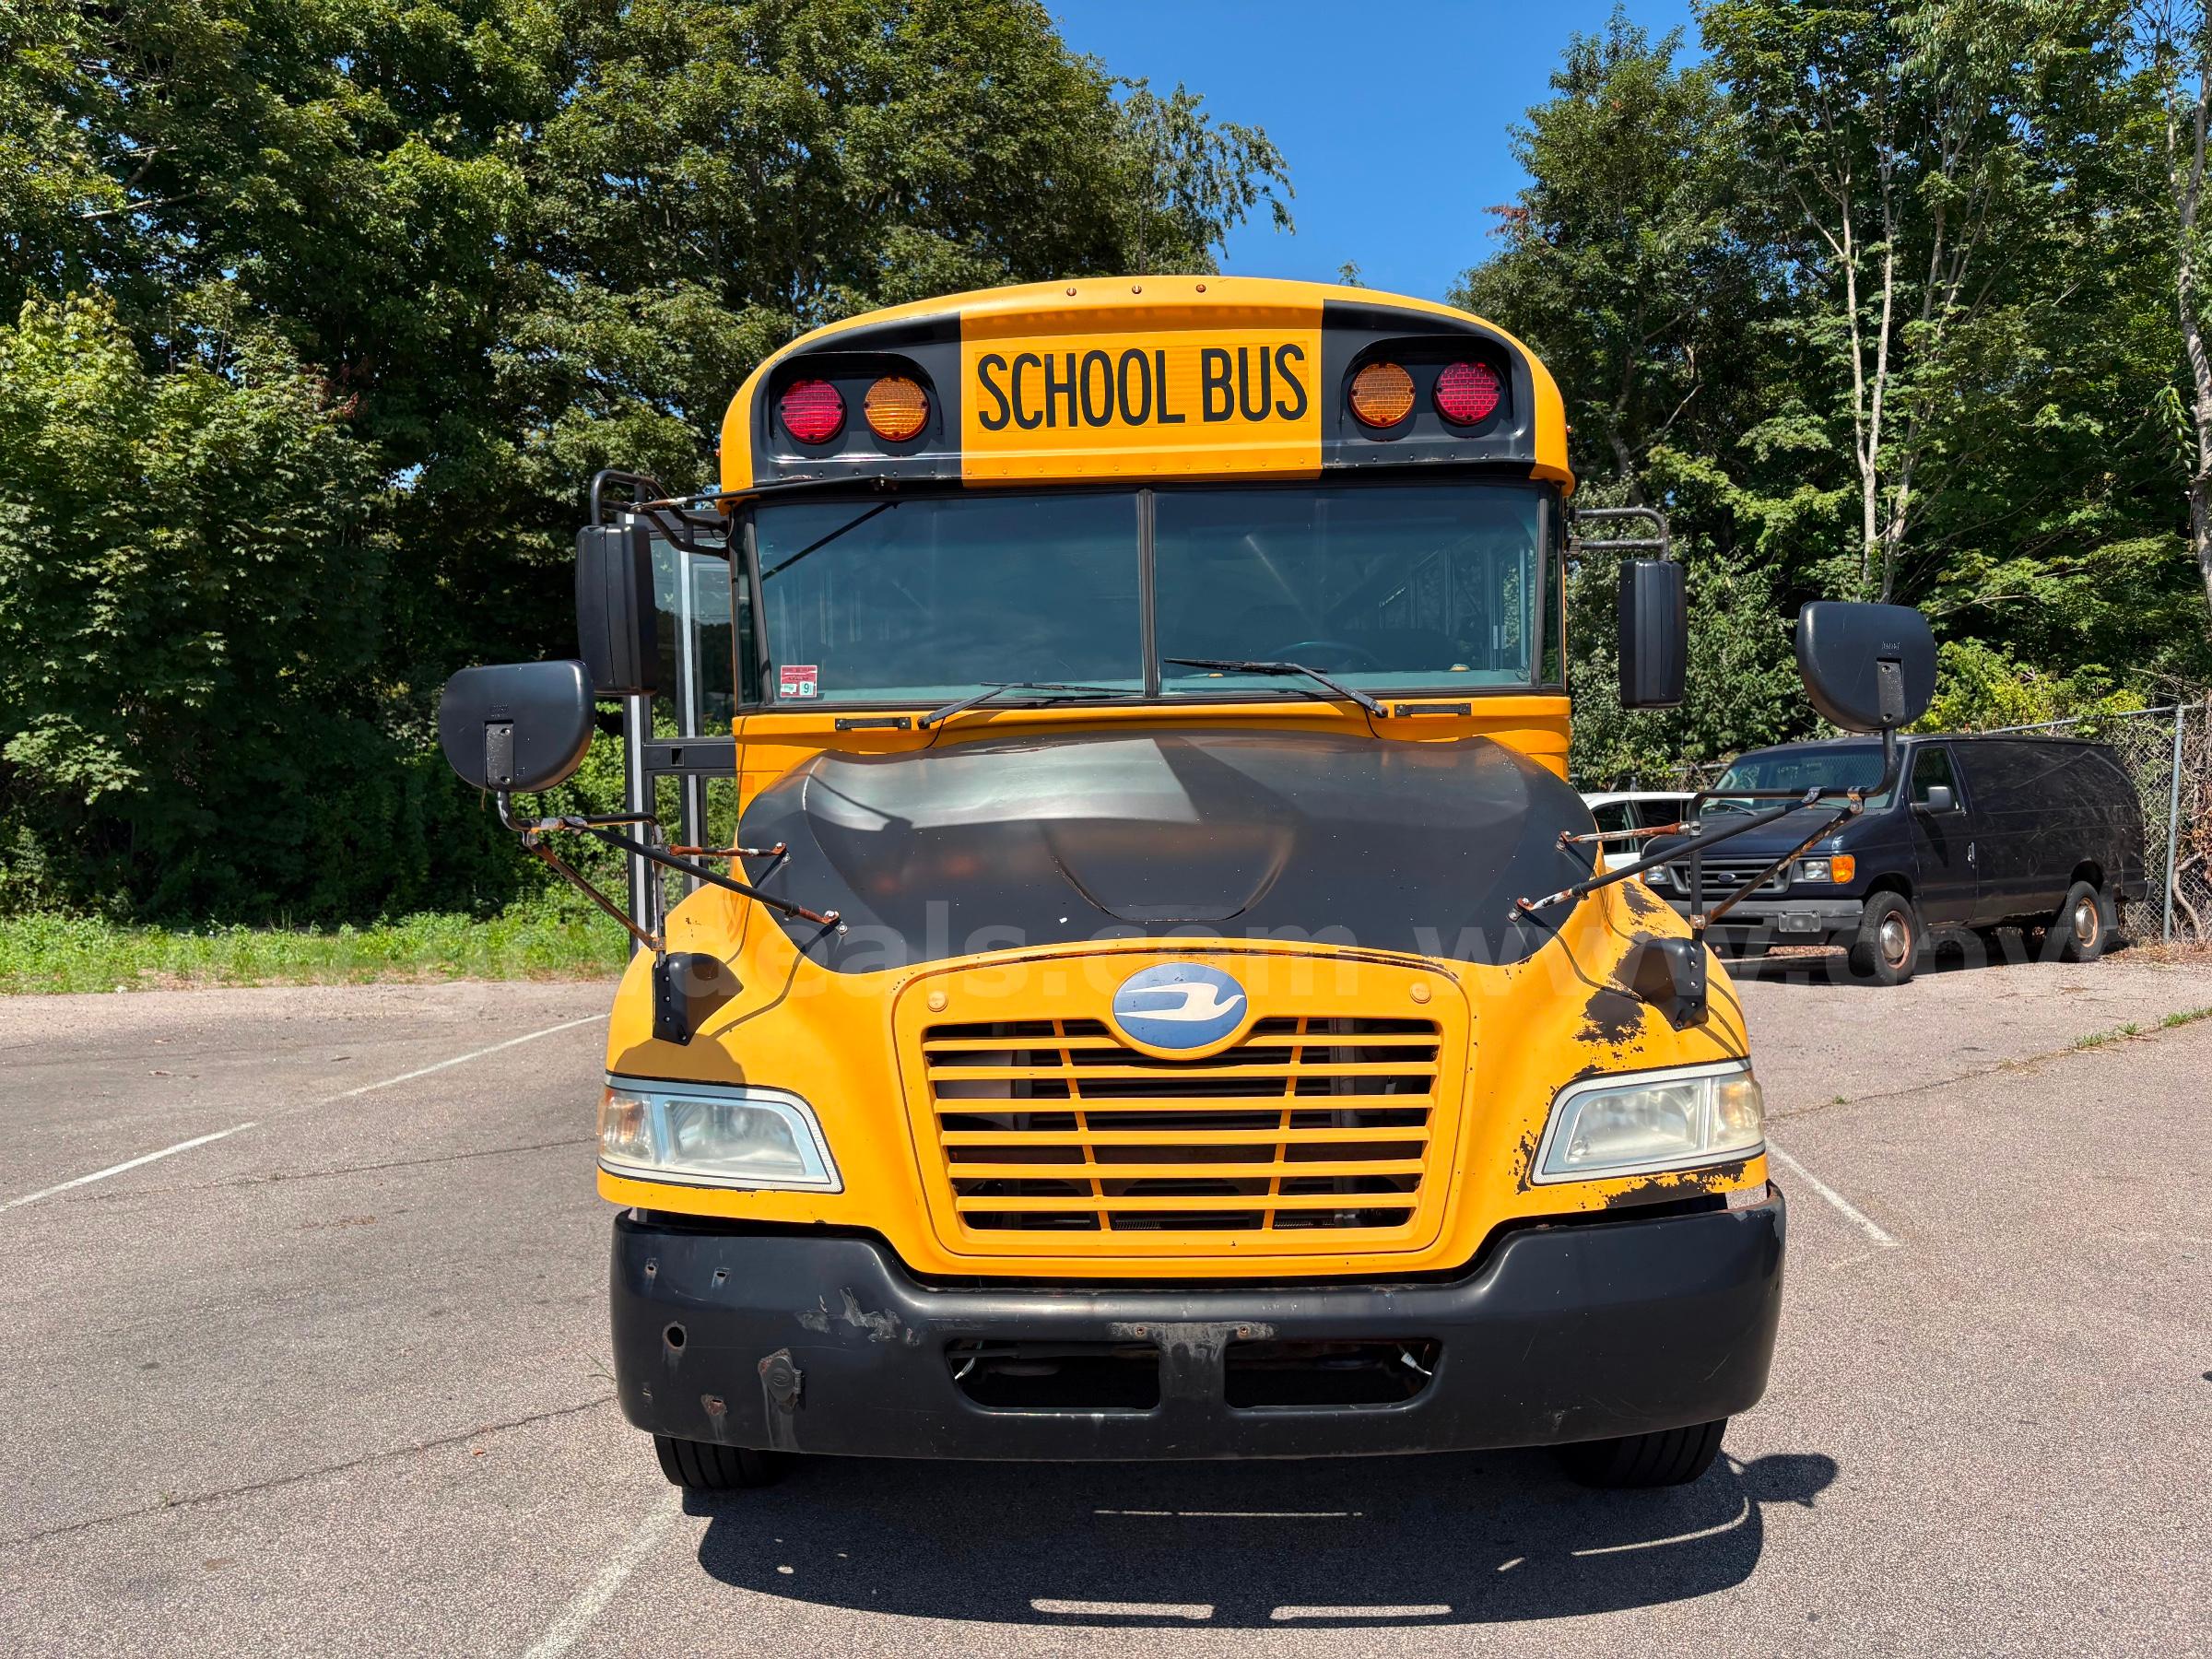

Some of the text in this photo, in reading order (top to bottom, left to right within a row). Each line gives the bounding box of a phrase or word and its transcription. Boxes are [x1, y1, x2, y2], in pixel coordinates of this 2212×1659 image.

[978, 344, 1308, 431] SCHOOL BUS
[803, 682, 810, 694] 9
